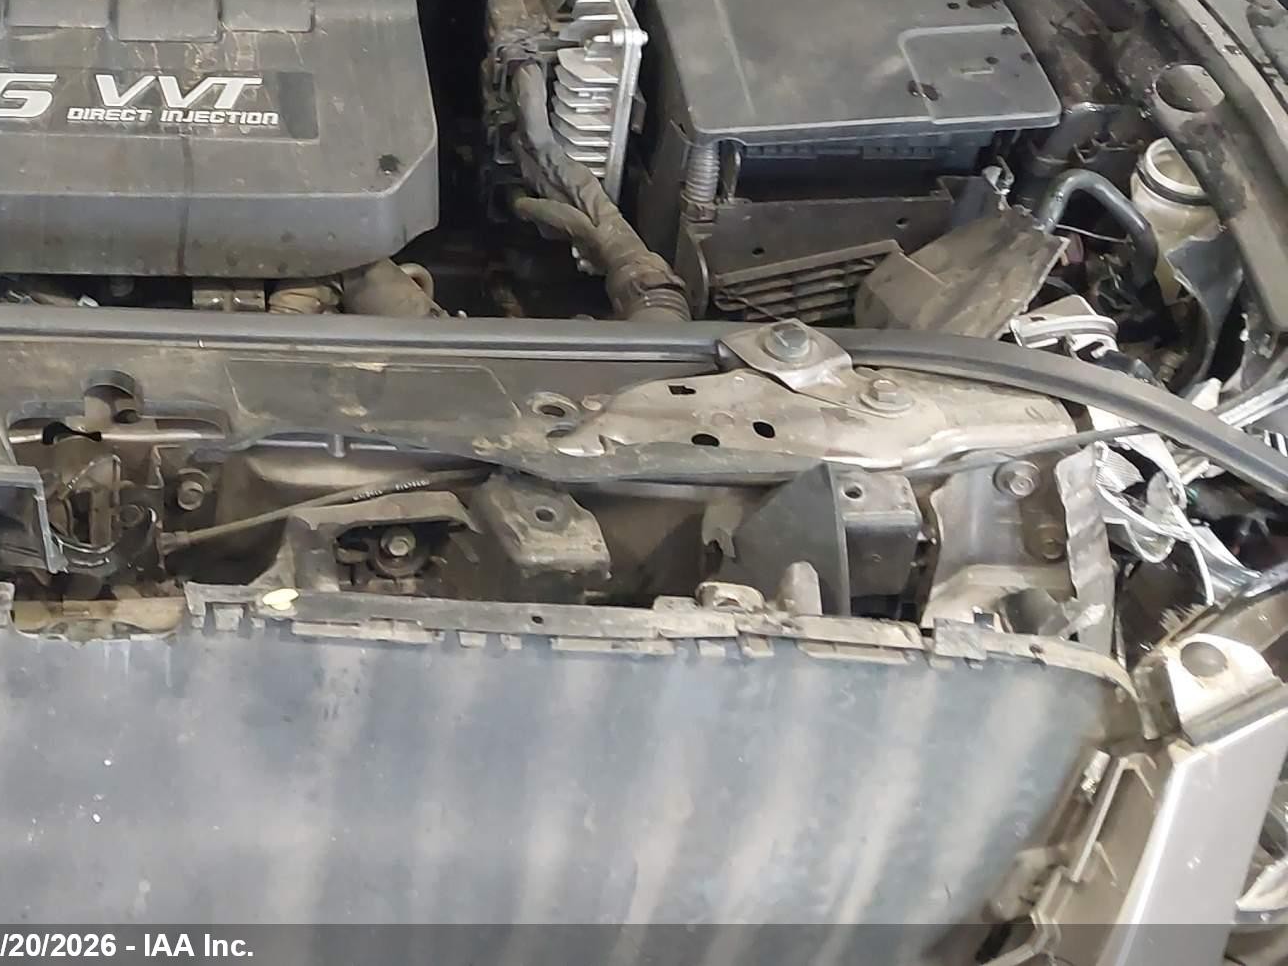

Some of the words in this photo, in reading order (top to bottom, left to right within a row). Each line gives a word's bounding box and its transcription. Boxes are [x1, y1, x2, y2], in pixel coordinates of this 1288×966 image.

[95, 74, 263, 110] VVT
[66, 108, 153, 124] DIRECT
[160, 110, 279, 126] INJECTION
